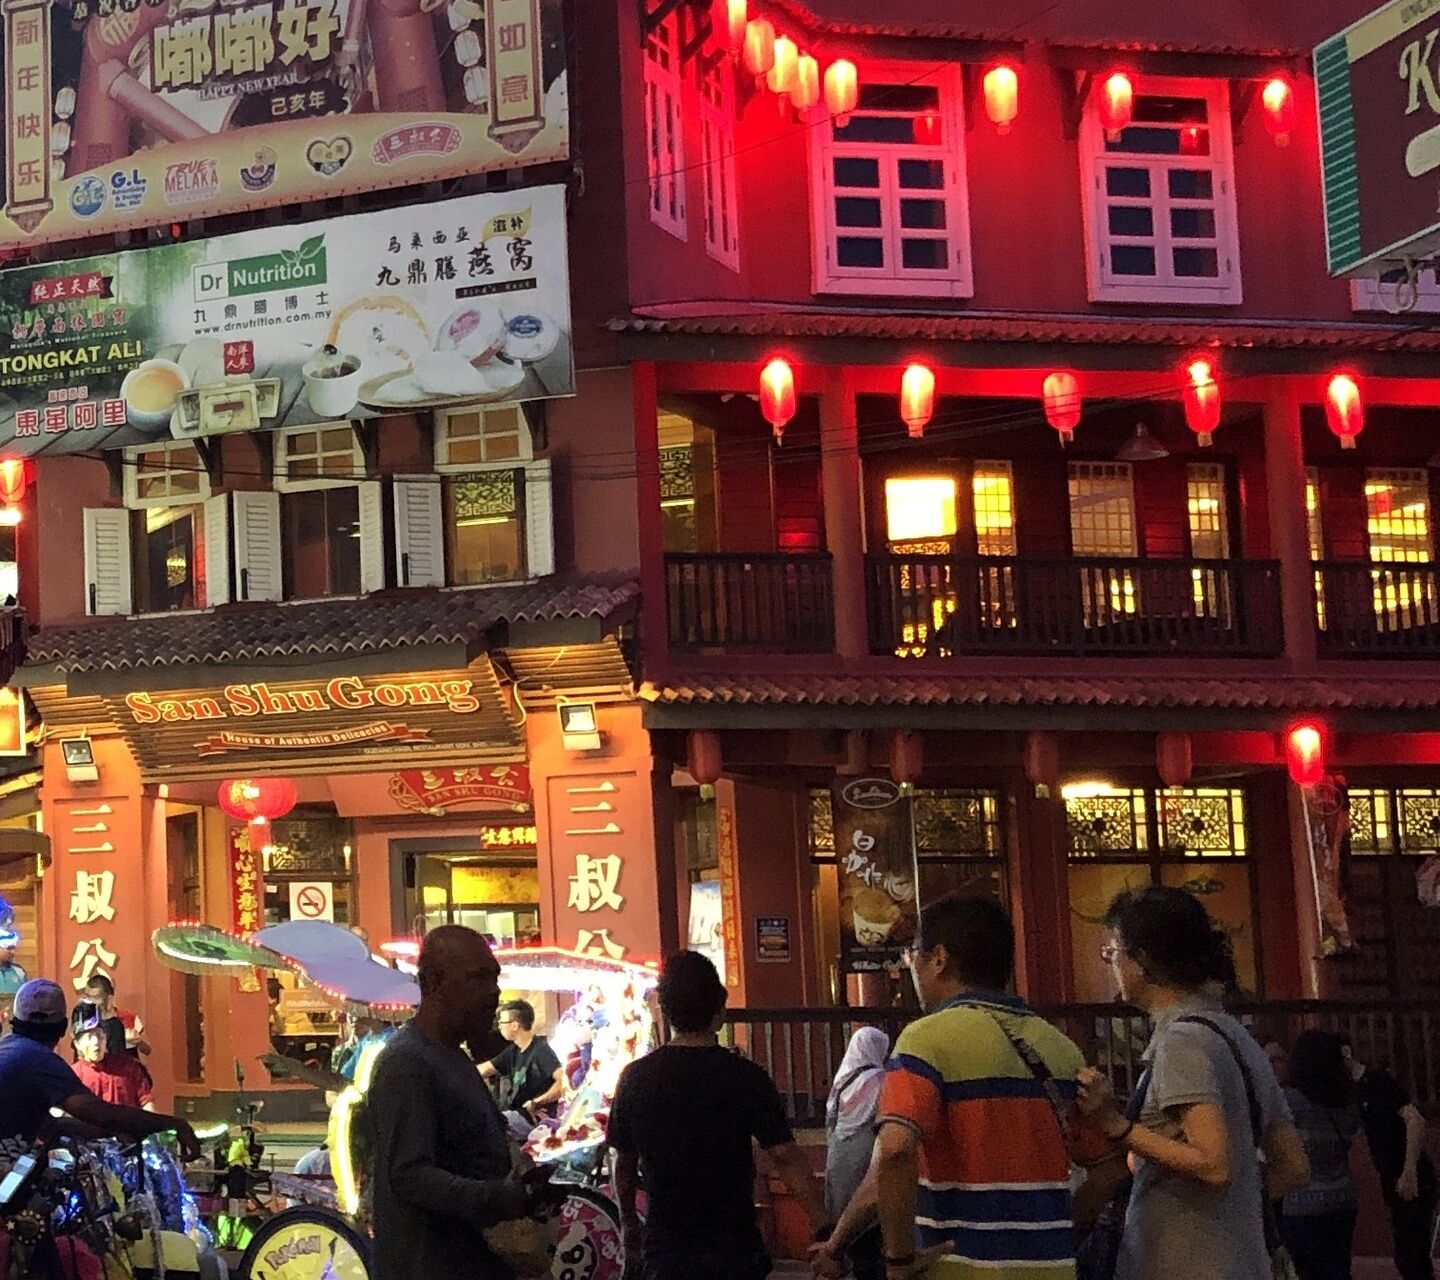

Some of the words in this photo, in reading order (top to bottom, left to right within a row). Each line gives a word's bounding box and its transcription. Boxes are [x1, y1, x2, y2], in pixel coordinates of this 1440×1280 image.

[198, 84, 237, 101] HAPPY
[239, 79, 265, 94] NEW
[267, 72, 299, 88] YEAR
[16, 19, 41, 186] 新年快乐
[271, 91, 326, 116] 己亥年
[111, 170, 147, 188] G.L.
[164, 170, 219, 193] MELAKA
[200, 274, 224, 292] Dr
[233, 262, 317, 287] Nutrition
[194, 309, 332, 335] www.drnutrition.com.my
[107, 340, 143, 360] ALI
[124, 690, 228, 725] San
[224, 682, 331, 718] Shu
[327, 676, 481, 715] Gong
[225, 731, 262, 746] House
[263, 734, 276, 748] of
[278, 733, 331, 748] Authentic
[332, 723, 389, 742] Delicacies
[427, 789, 452, 803] SAN
[482, 786, 522, 801] GONG
[68, 803, 118, 991] 三叔公
